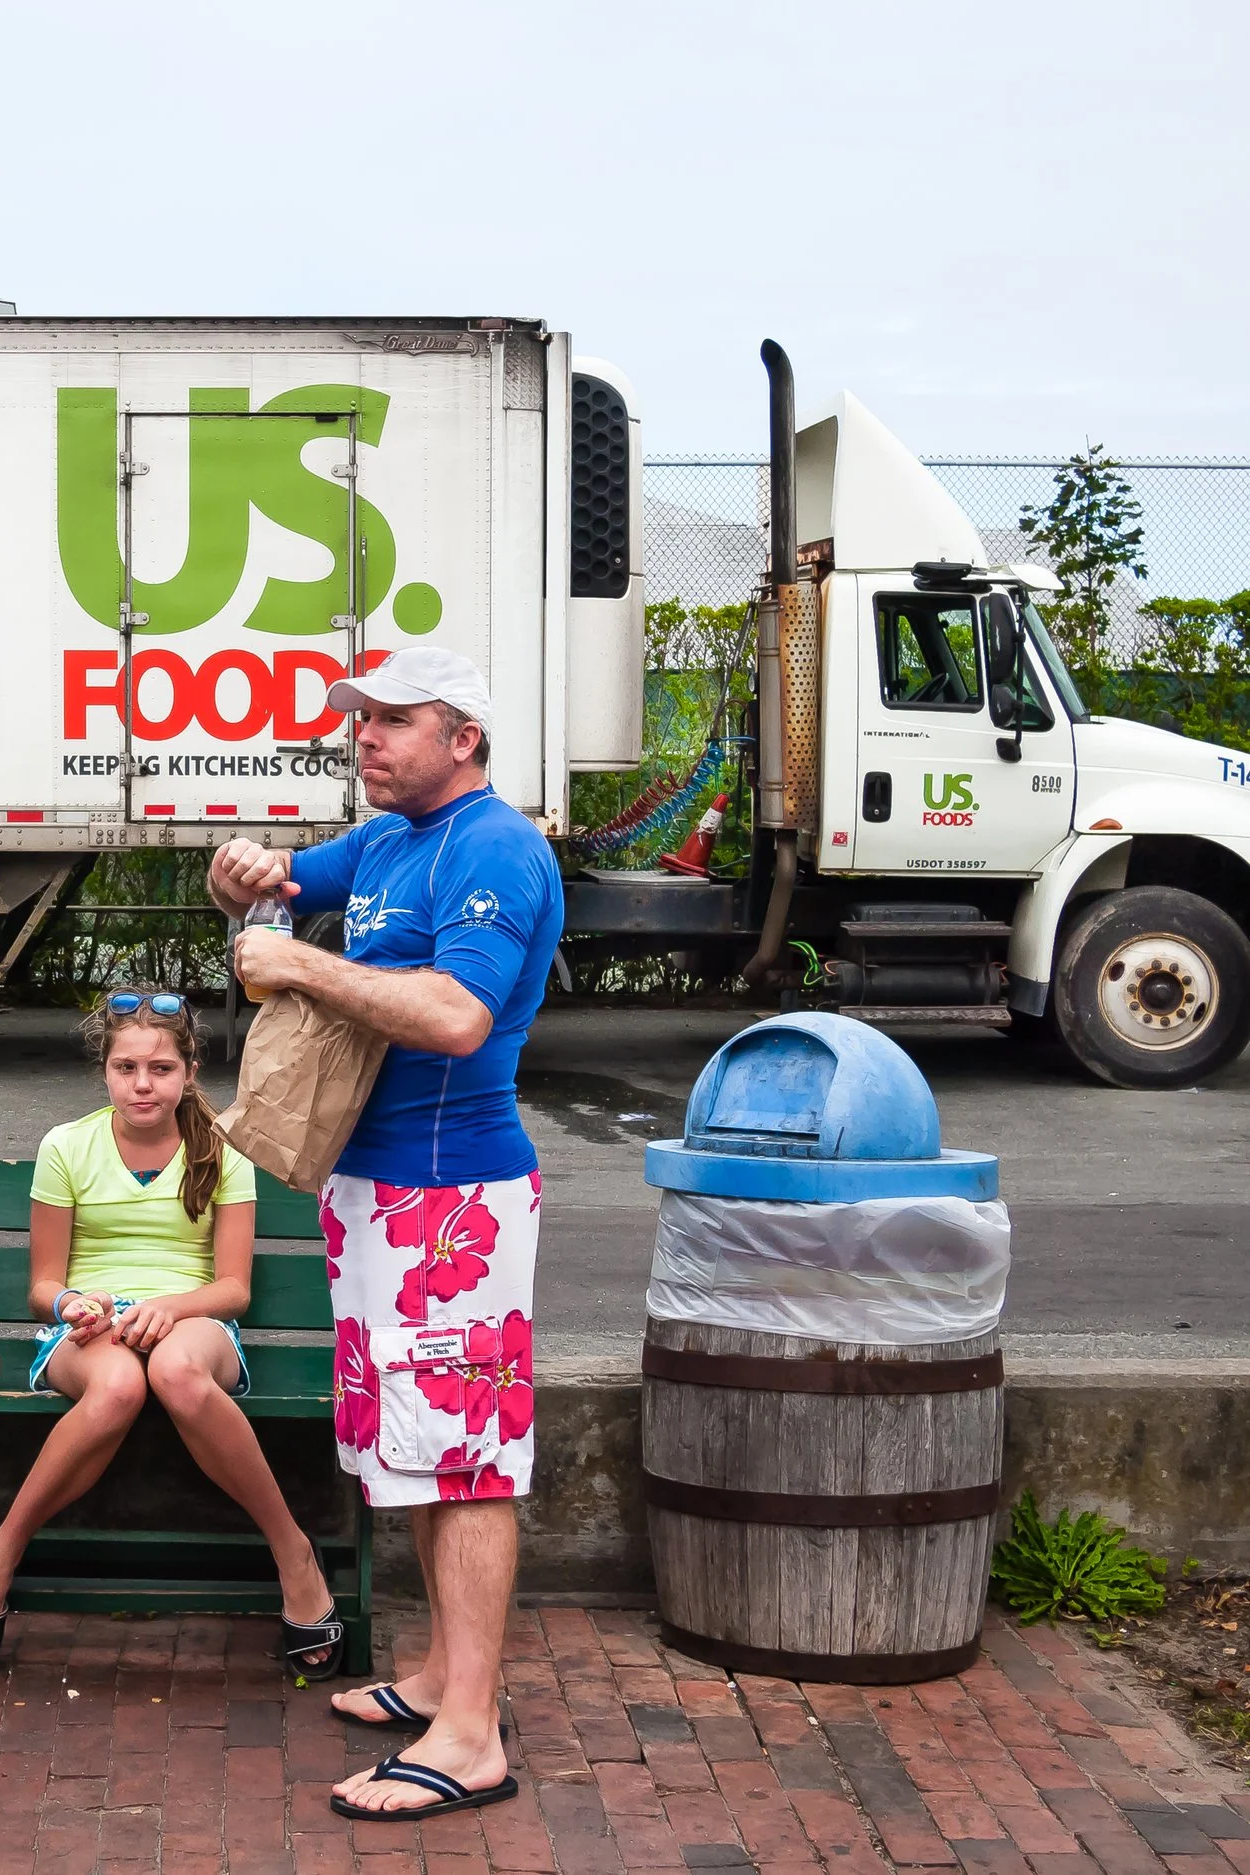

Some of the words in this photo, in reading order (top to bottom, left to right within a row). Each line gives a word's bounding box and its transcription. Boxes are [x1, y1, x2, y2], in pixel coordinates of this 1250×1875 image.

[57, 384, 442, 635] US.
[169, 755, 283, 776] KITCHENS
[923, 773, 980, 811] US.
[1031, 775, 1062, 793] 8500
[922, 812, 974, 827] FOODS
[906, 859, 945, 869] USDOT
[946, 860, 987, 869] 358597
[418, 1339, 457, 1350] Abercrombie
